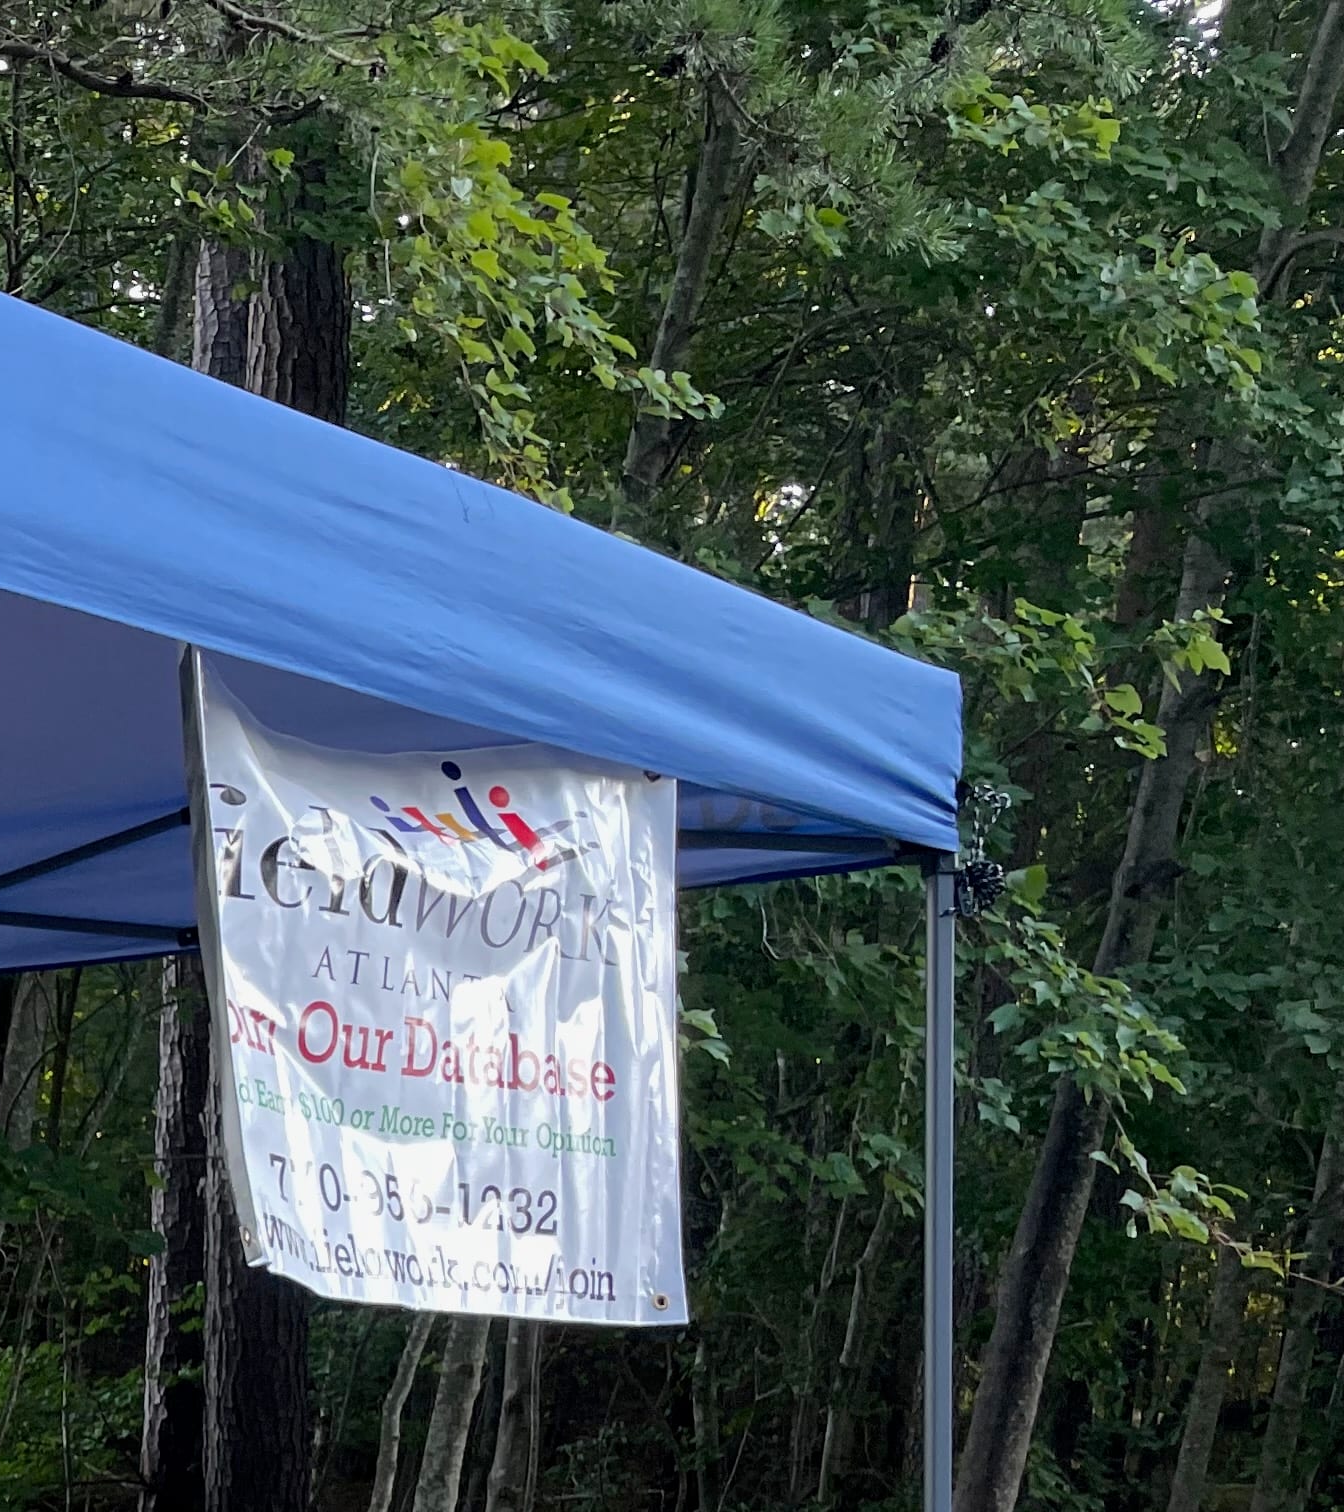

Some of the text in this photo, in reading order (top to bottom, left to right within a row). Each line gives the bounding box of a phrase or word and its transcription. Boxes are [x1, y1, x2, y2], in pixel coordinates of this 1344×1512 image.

[297, 1000, 394, 1073] Our
[400, 1016, 616, 1102] Database
[298, 1091, 345, 1127] $100
[350, 1107, 375, 1131] or
[379, 1104, 435, 1138] More
[440, 1112, 479, 1142] For
[482, 1115, 530, 1148] Your
[268, 1152, 559, 1237] 70-956-1232
